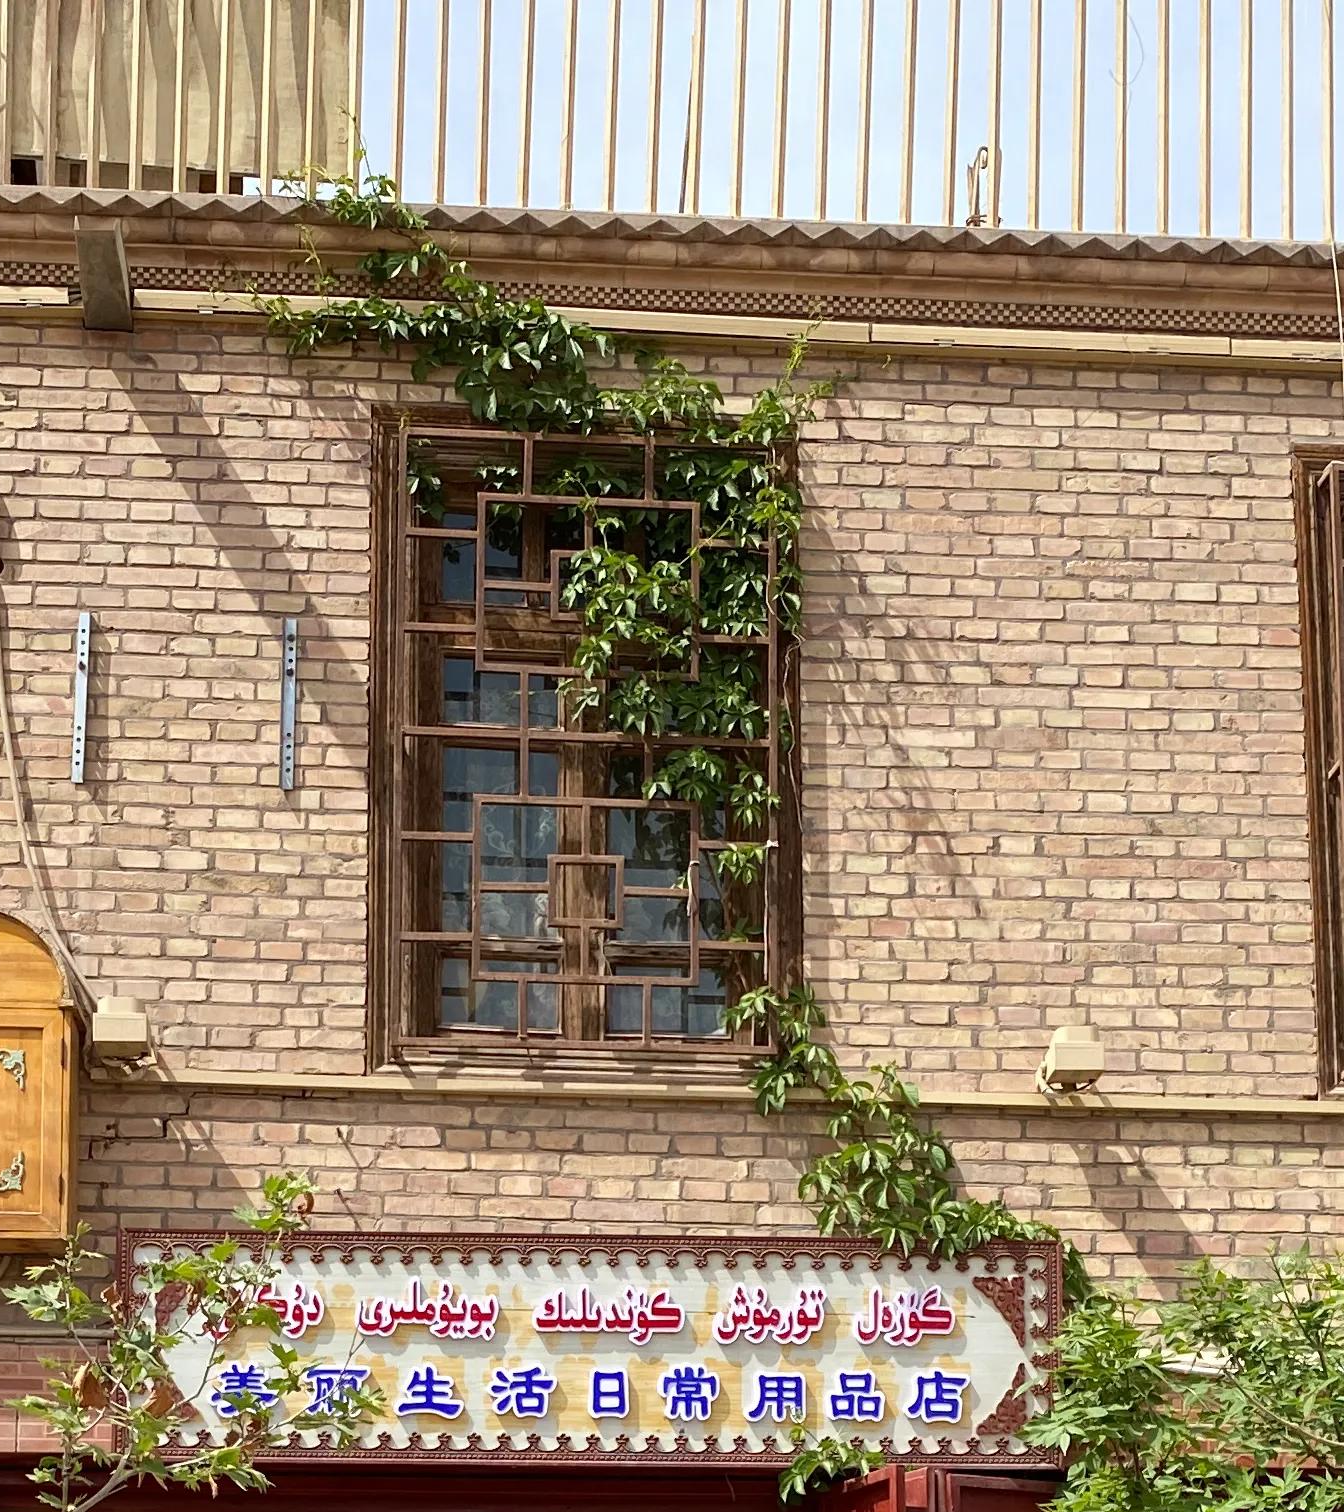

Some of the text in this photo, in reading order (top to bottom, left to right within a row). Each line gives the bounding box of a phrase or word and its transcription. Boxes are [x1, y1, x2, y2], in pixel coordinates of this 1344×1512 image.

[211, 1363, 968, 1420] 美丽生活日常用品店
